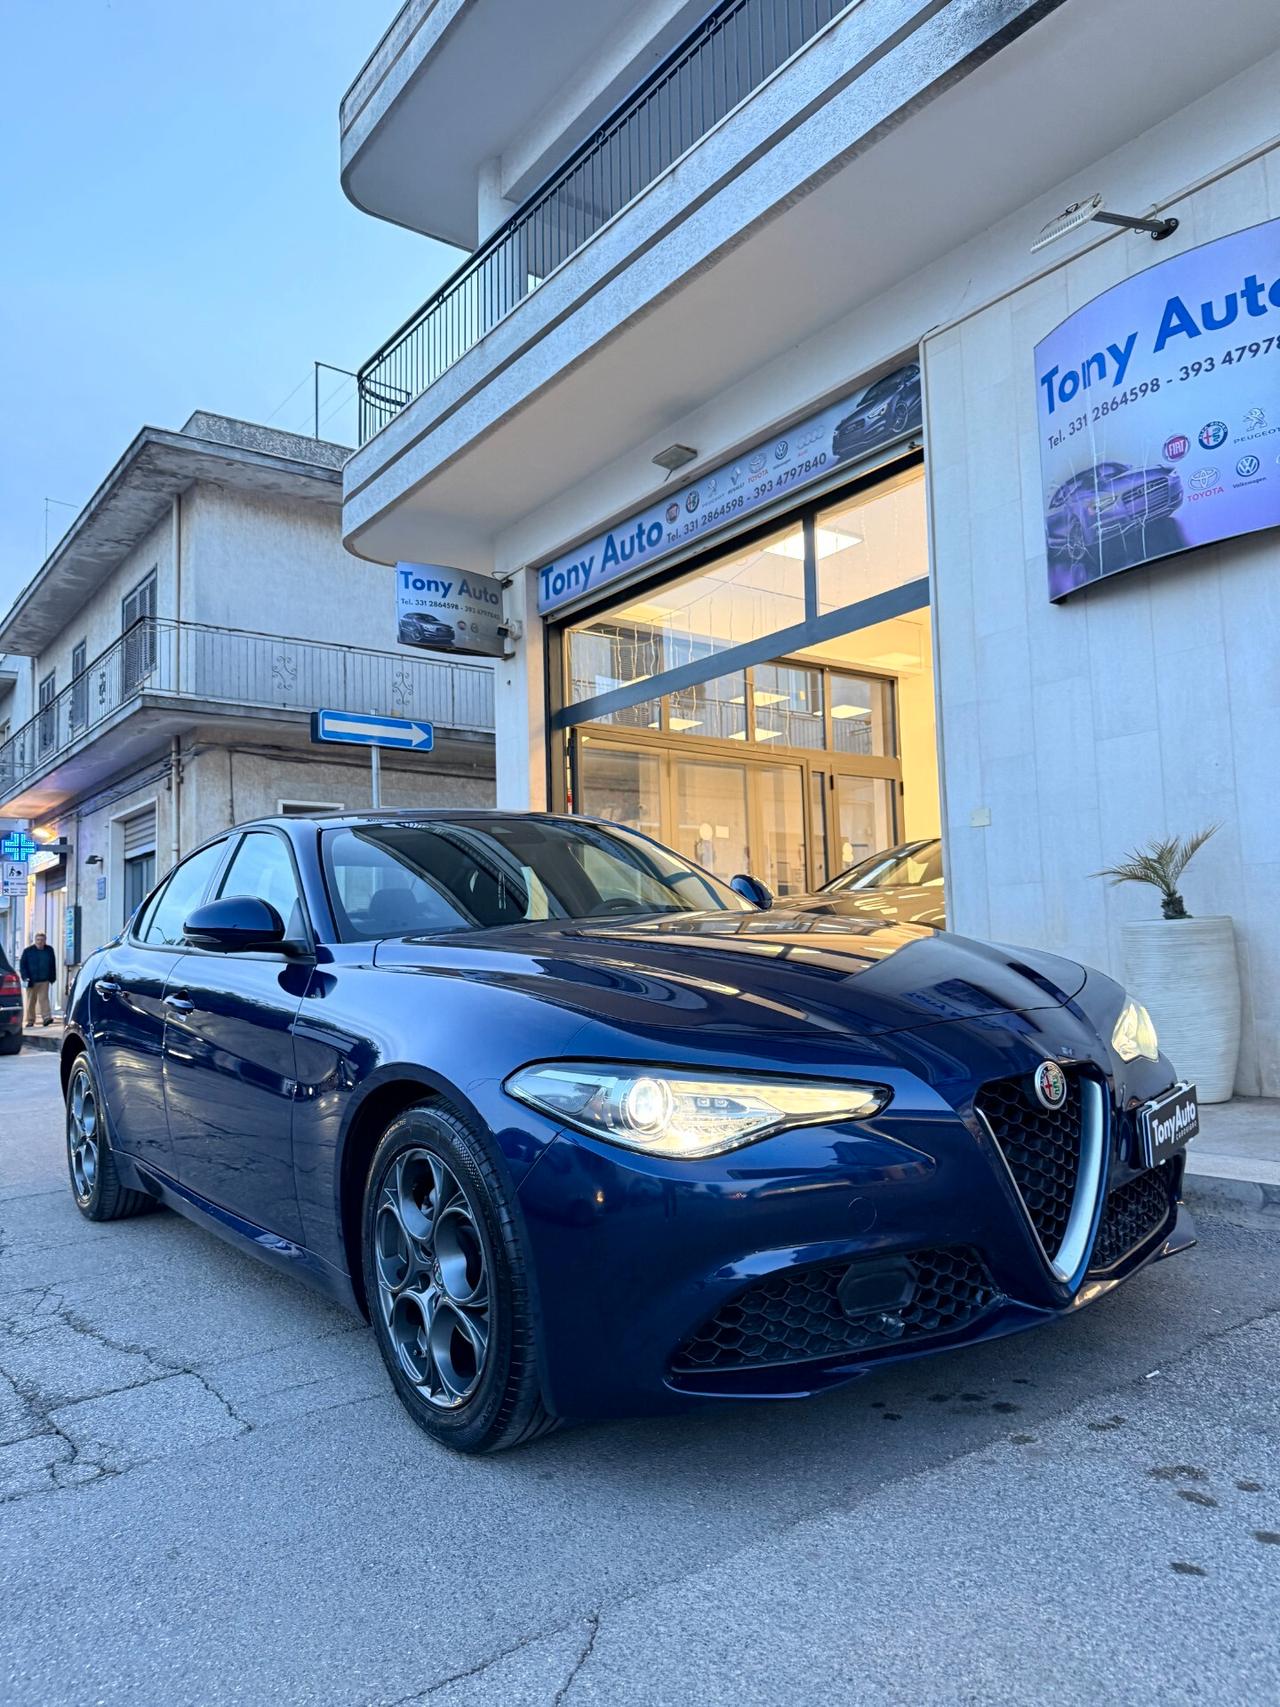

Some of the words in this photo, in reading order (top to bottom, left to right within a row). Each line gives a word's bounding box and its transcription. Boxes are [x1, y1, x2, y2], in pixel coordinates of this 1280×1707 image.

[1041, 331, 1138, 415] Tony
[1048, 429, 1066, 449] Tel.
[1069, 413, 1088, 436] 331
[1092, 378, 1161, 421] 2864598
[1179, 357, 1215, 382] 393
[1168, 440, 1185, 457] FIAT
[748, 469, 769, 483] TOYOTA
[667, 530, 681, 544] Tel.
[684, 519, 699, 536] 331
[701, 495, 744, 526] 2864598
[754, 480, 773, 499] 393
[776, 452, 827, 486] 4797840
[1187, 486, 1224, 502] TOYOTA
[541, 555, 595, 600] Tony
[601, 522, 663, 573] Auto
[400, 571, 453, 598] Tony
[458, 579, 499, 605] Auto
[429, 600, 459, 610] 2864598
